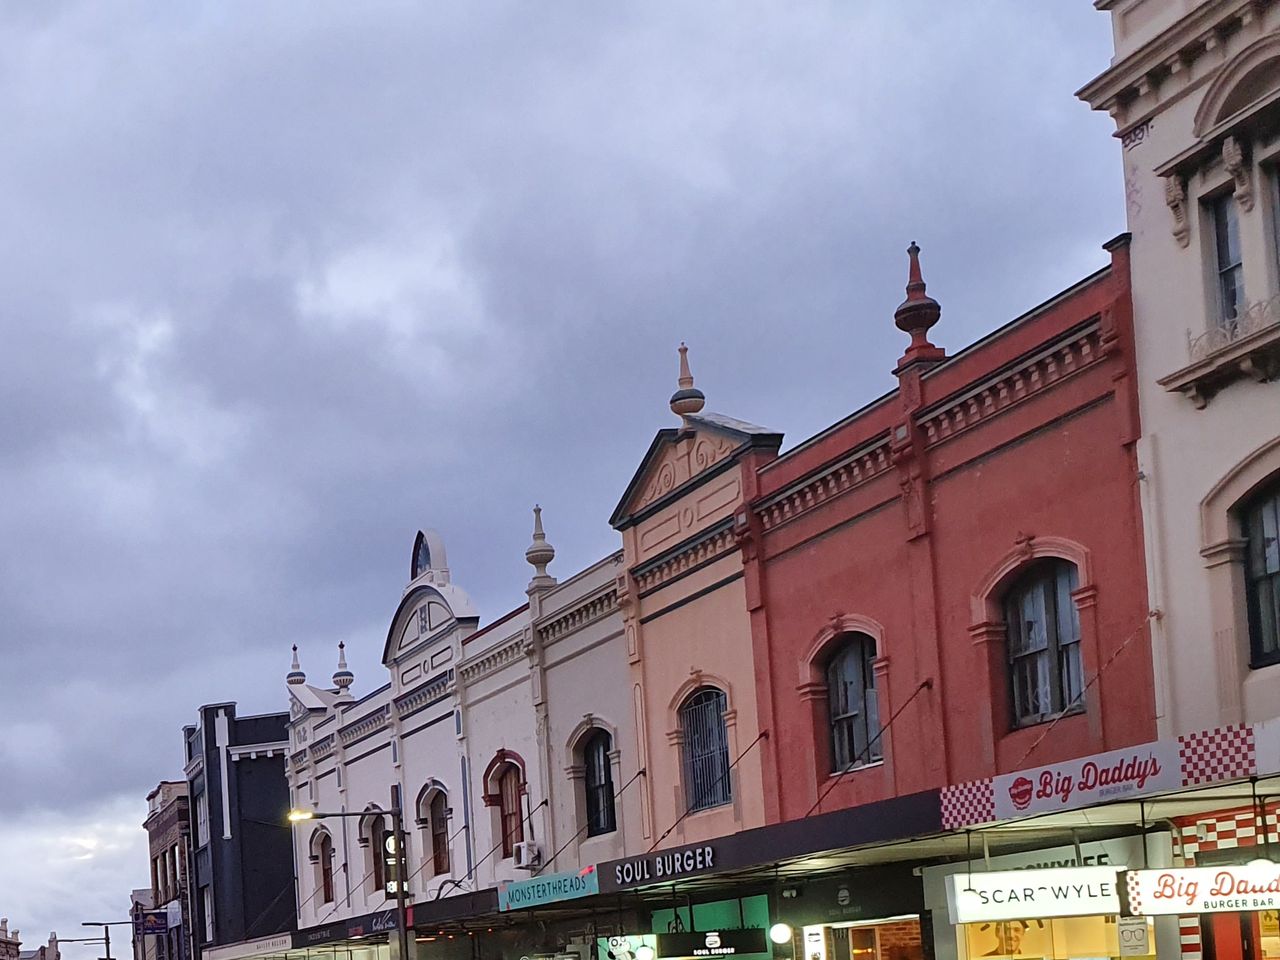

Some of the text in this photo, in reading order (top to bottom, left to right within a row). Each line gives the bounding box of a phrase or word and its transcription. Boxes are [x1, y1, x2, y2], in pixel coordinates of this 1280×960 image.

[1036, 752, 1162, 802] Big Daddy's
[615, 849, 714, 884] SOUL BURGER
[508, 876, 587, 903] MONSTERTHREADS
[979, 883, 1111, 905] SCAR WYLE
[1153, 873, 1198, 905] Big
[1204, 898, 1274, 909] BURGER BAR
